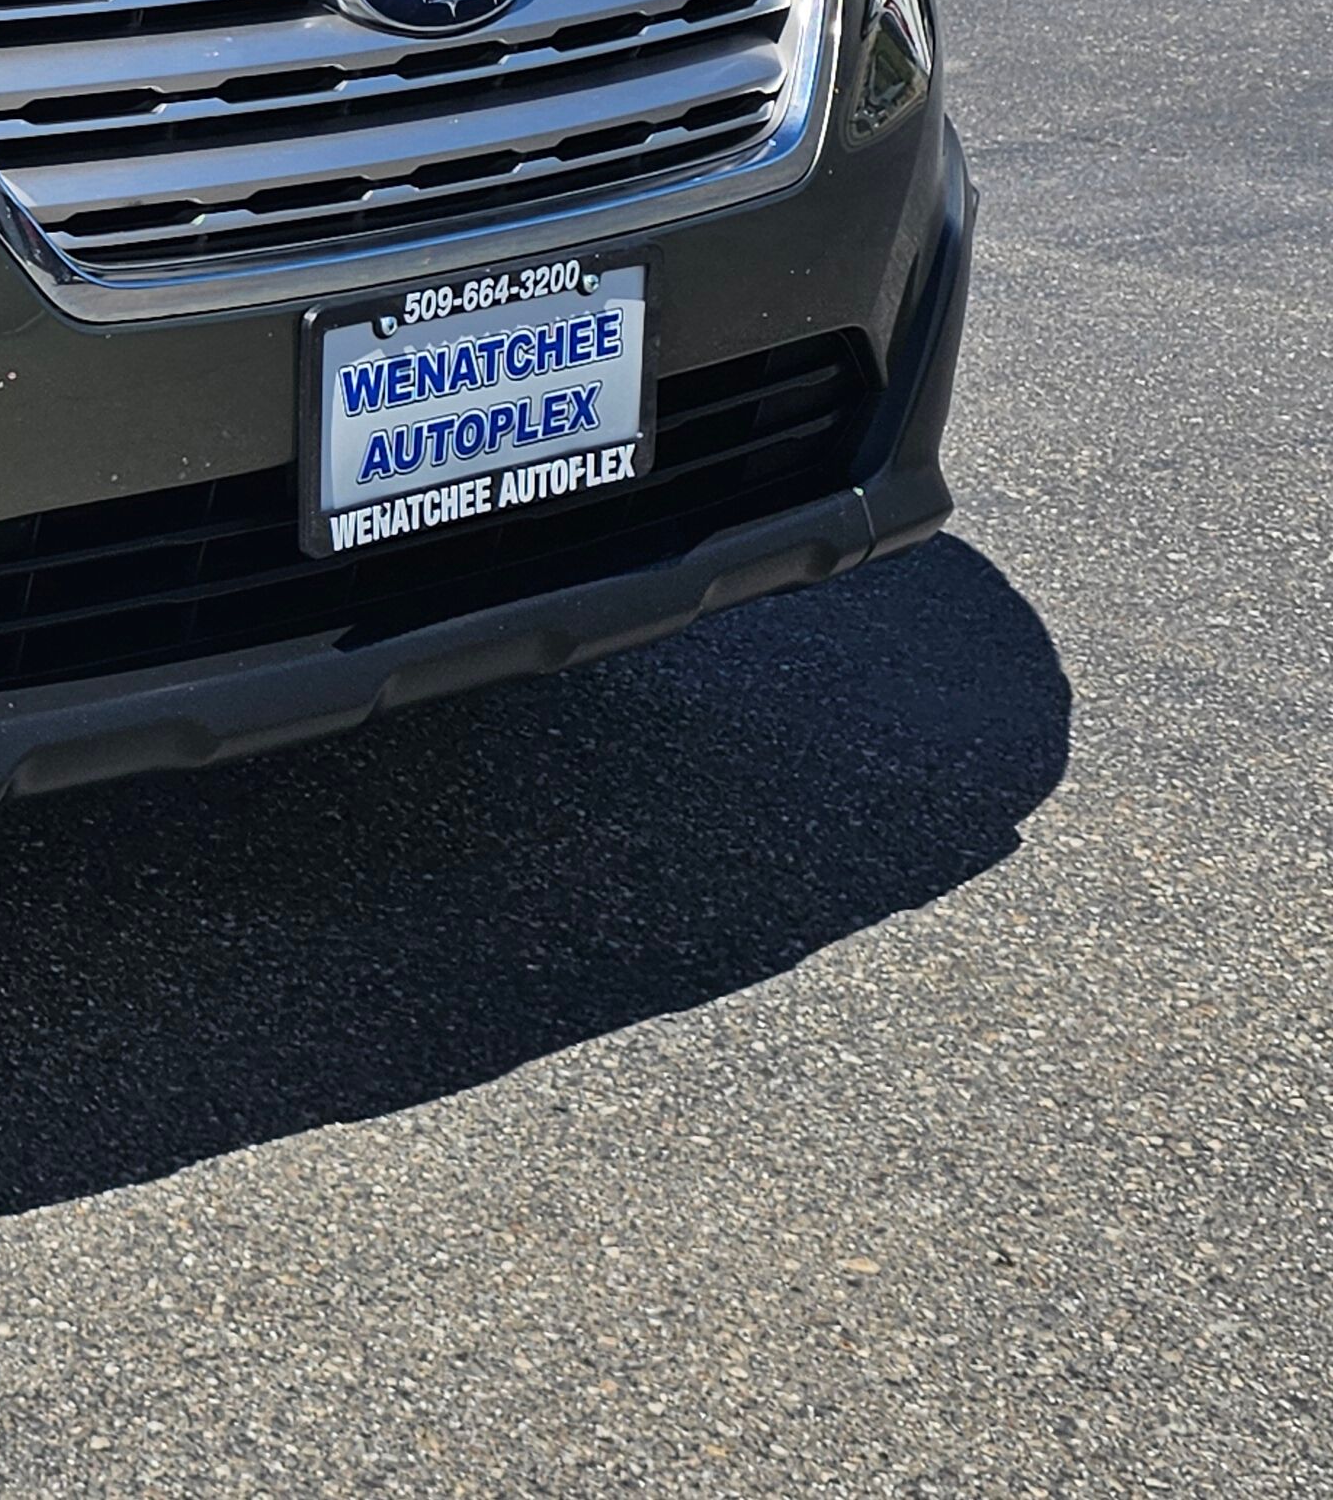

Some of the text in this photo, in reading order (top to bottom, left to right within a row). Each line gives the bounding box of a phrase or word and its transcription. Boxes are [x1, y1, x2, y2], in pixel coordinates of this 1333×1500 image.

[404, 259, 582, 324] 509-664-3200
[339, 308, 624, 417] WENATCHEE
[357, 382, 602, 484] AUTOPLEX
[330, 476, 493, 552] WENATCHEE
